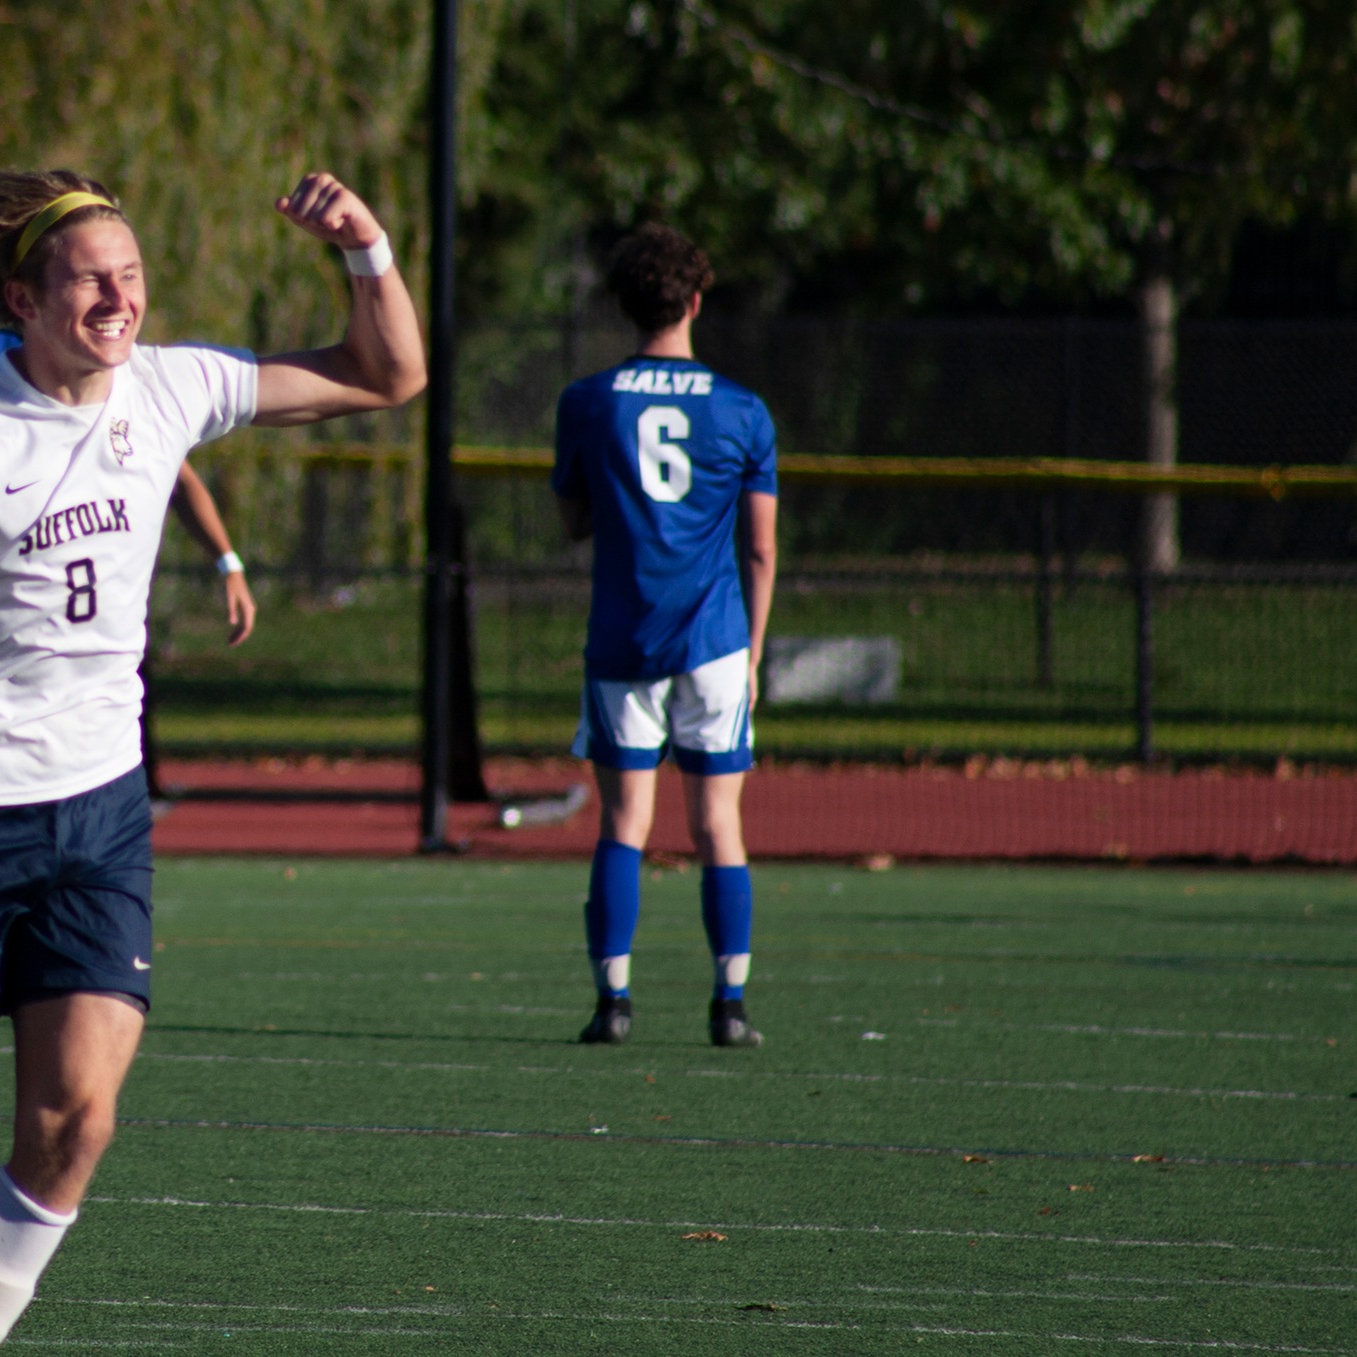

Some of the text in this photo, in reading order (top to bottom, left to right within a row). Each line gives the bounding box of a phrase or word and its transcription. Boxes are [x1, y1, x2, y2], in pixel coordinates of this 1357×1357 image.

[612, 369, 713, 395] SALVE
[638, 405, 691, 502] 6
[18, 498, 130, 556] SUFFOLK
[66, 558, 97, 623] 8
